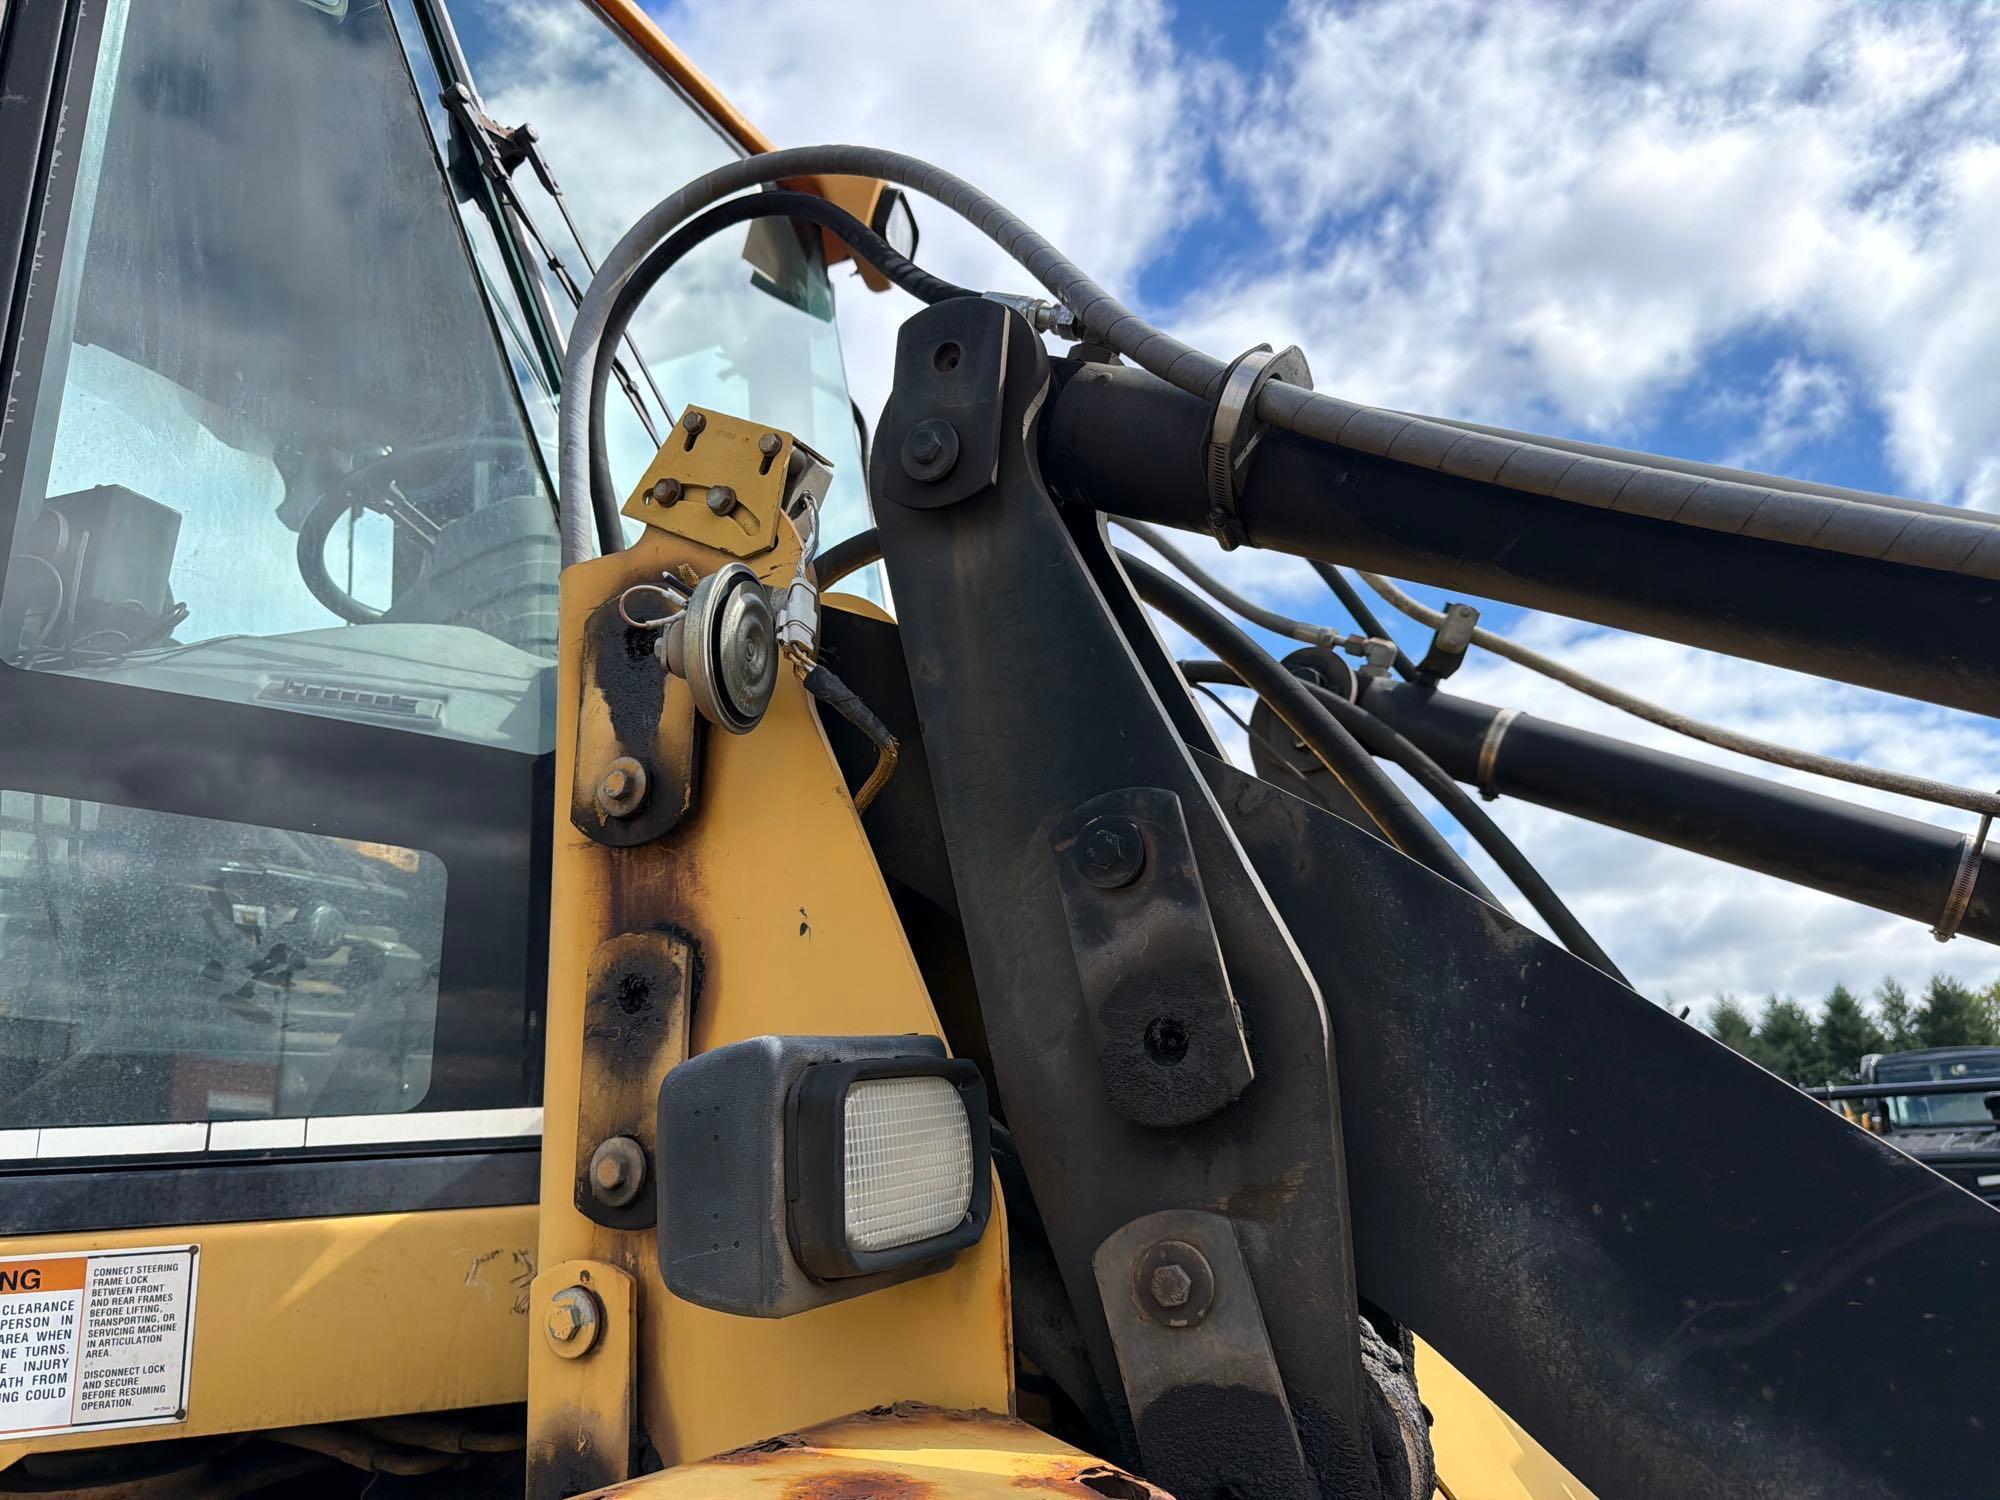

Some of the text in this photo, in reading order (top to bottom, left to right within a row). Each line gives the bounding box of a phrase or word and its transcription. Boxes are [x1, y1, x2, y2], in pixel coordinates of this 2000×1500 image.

[94, 1263, 178, 1277] CONNECT STEERING
[0, 1268, 40, 1292] NG
[92, 1276, 148, 1287] FRAME LOCK
[92, 1284, 164, 1297] BETWEEN FRONT
[90, 1294, 173, 1307] AND REAR FRAMES
[2, 1300, 75, 1316] CLEARANCE
[90, 1307, 123, 1318] BEFORE
[0, 1314, 73, 1331] PERSON IN
[163, 1313, 175, 1322] OR
[0, 1329, 72, 1344] AREA WHEN
[88, 1323, 177, 1338] SERVICING MACHINE
[87, 1334, 162, 1348] IN ARTICULATION
[2, 1344, 70, 1360] NE TURNS.
[86, 1349, 112, 1358] AREA.
[24, 1358, 70, 1372] INJURY
[84, 1364, 166, 1379] DISCONNECT LOCK
[0, 1372, 68, 1388] ATH FROM
[82, 1377, 139, 1390] AND SECURE
[26, 1388, 66, 1401] COULD
[82, 1385, 166, 1400] BEFORE RESUMING
[81, 1398, 134, 1411] OPERATION.
